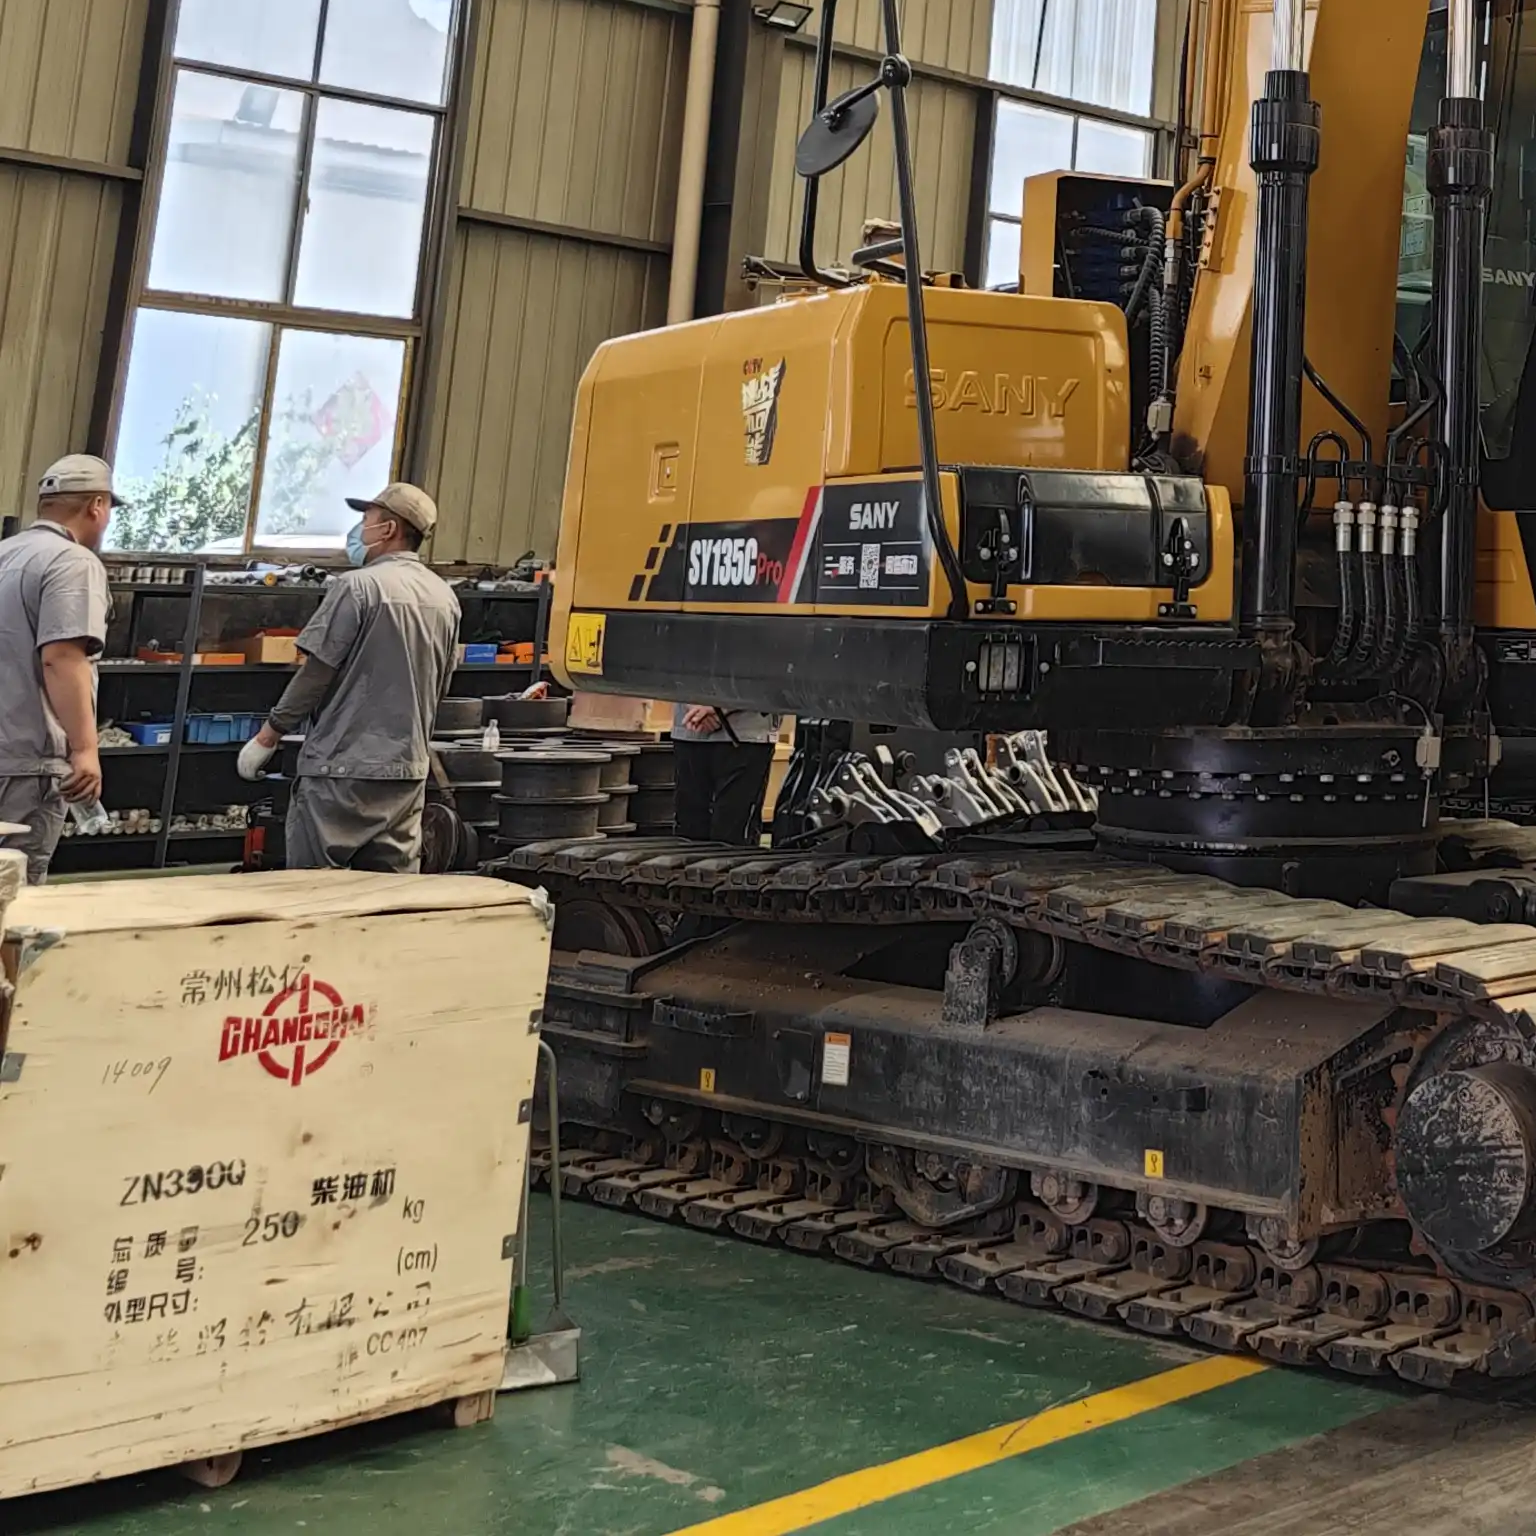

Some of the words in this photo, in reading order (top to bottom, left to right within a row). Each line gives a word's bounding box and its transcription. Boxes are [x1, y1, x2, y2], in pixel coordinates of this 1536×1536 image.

[1482, 267, 1536, 287] SANY
[904, 368, 1080, 418] SANY
[849, 501, 900, 530] SANY
[688, 537, 758, 587] SY135C
[756, 552, 783, 587] Pro
[311, 1168, 397, 1206] 柴油机
[402, 1195, 425, 1223] kg
[242, 1210, 301, 1247] 250
[397, 1244, 438, 1276] (cm)
